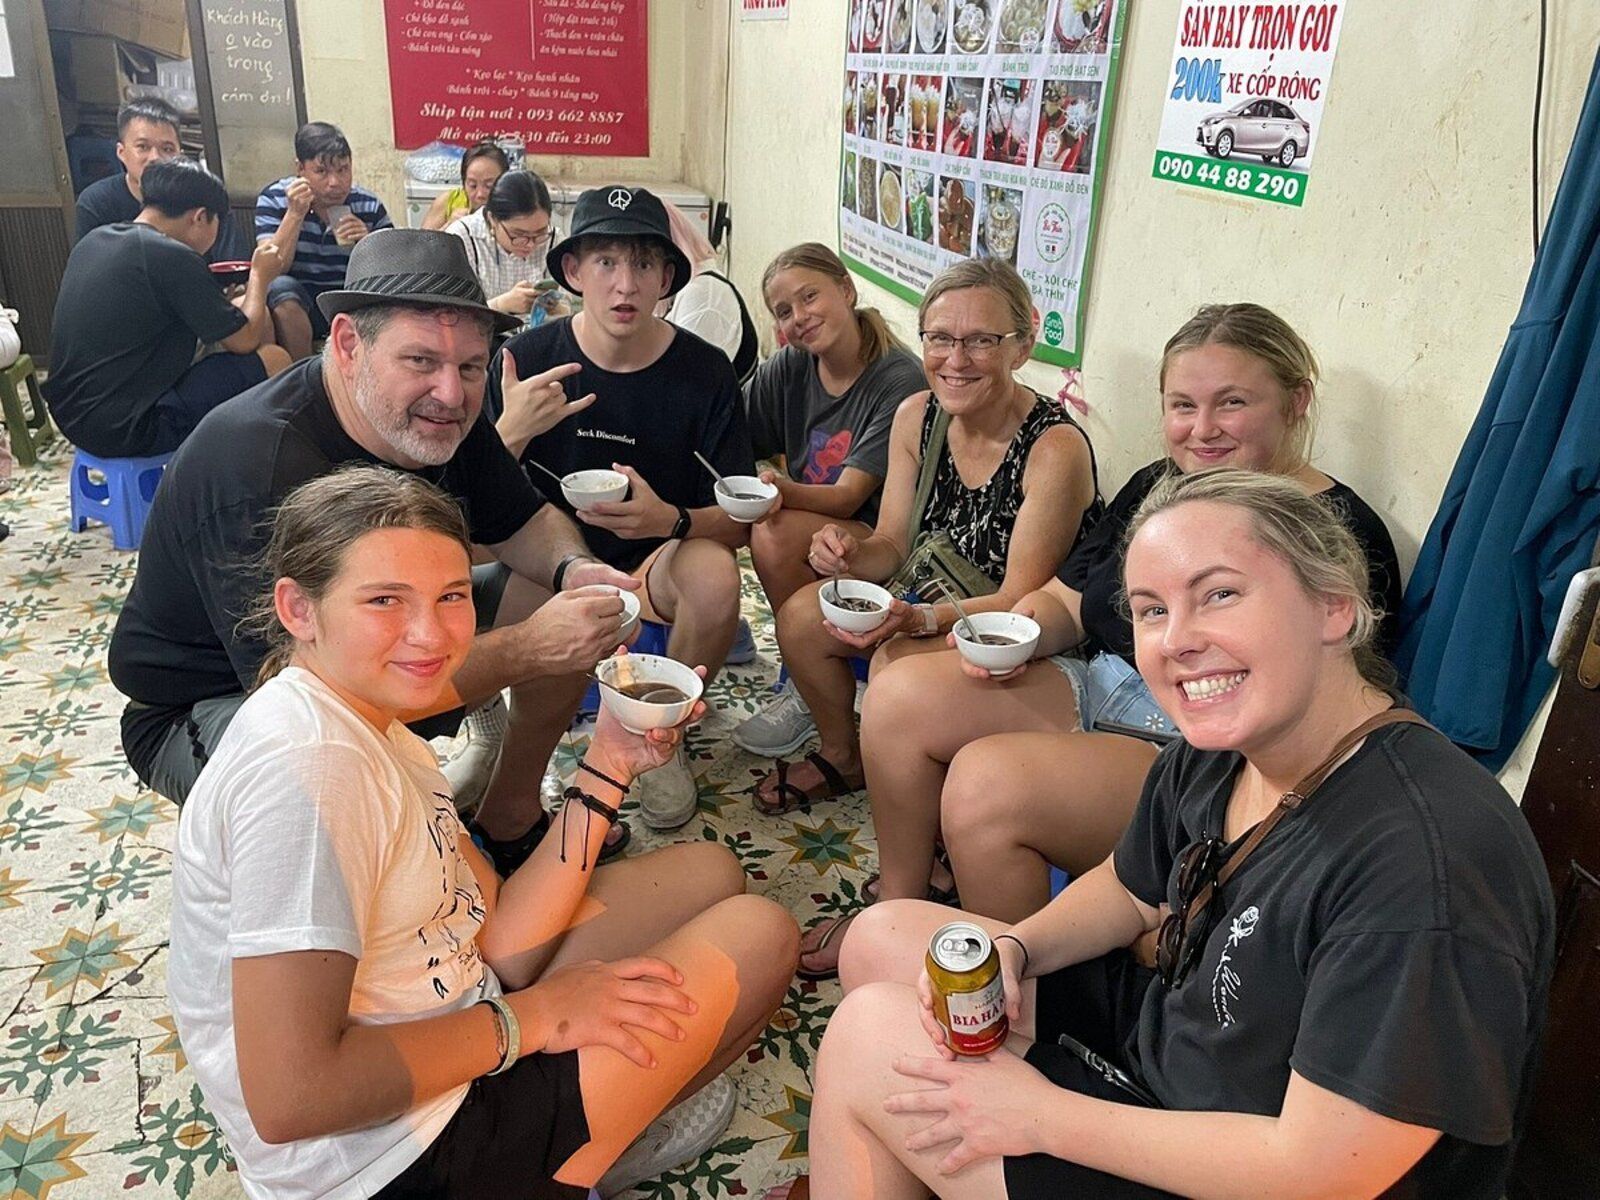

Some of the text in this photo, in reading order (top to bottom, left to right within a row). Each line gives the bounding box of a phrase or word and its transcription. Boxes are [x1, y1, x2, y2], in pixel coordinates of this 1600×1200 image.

[1212, 5, 1251, 48] BAY
[1227, 72, 1245, 94] XE
[419, 102, 456, 121] Ship
[526, 108, 554, 121] 093
[558, 109, 584, 123] 662
[588, 110, 624, 124] 8887
[573, 133, 612, 145] 23:00
[1159, 155, 1299, 200] 090 44 88 290
[576, 428, 636, 445] Seek Discomfort
[952, 1014, 980, 1026] BIA
